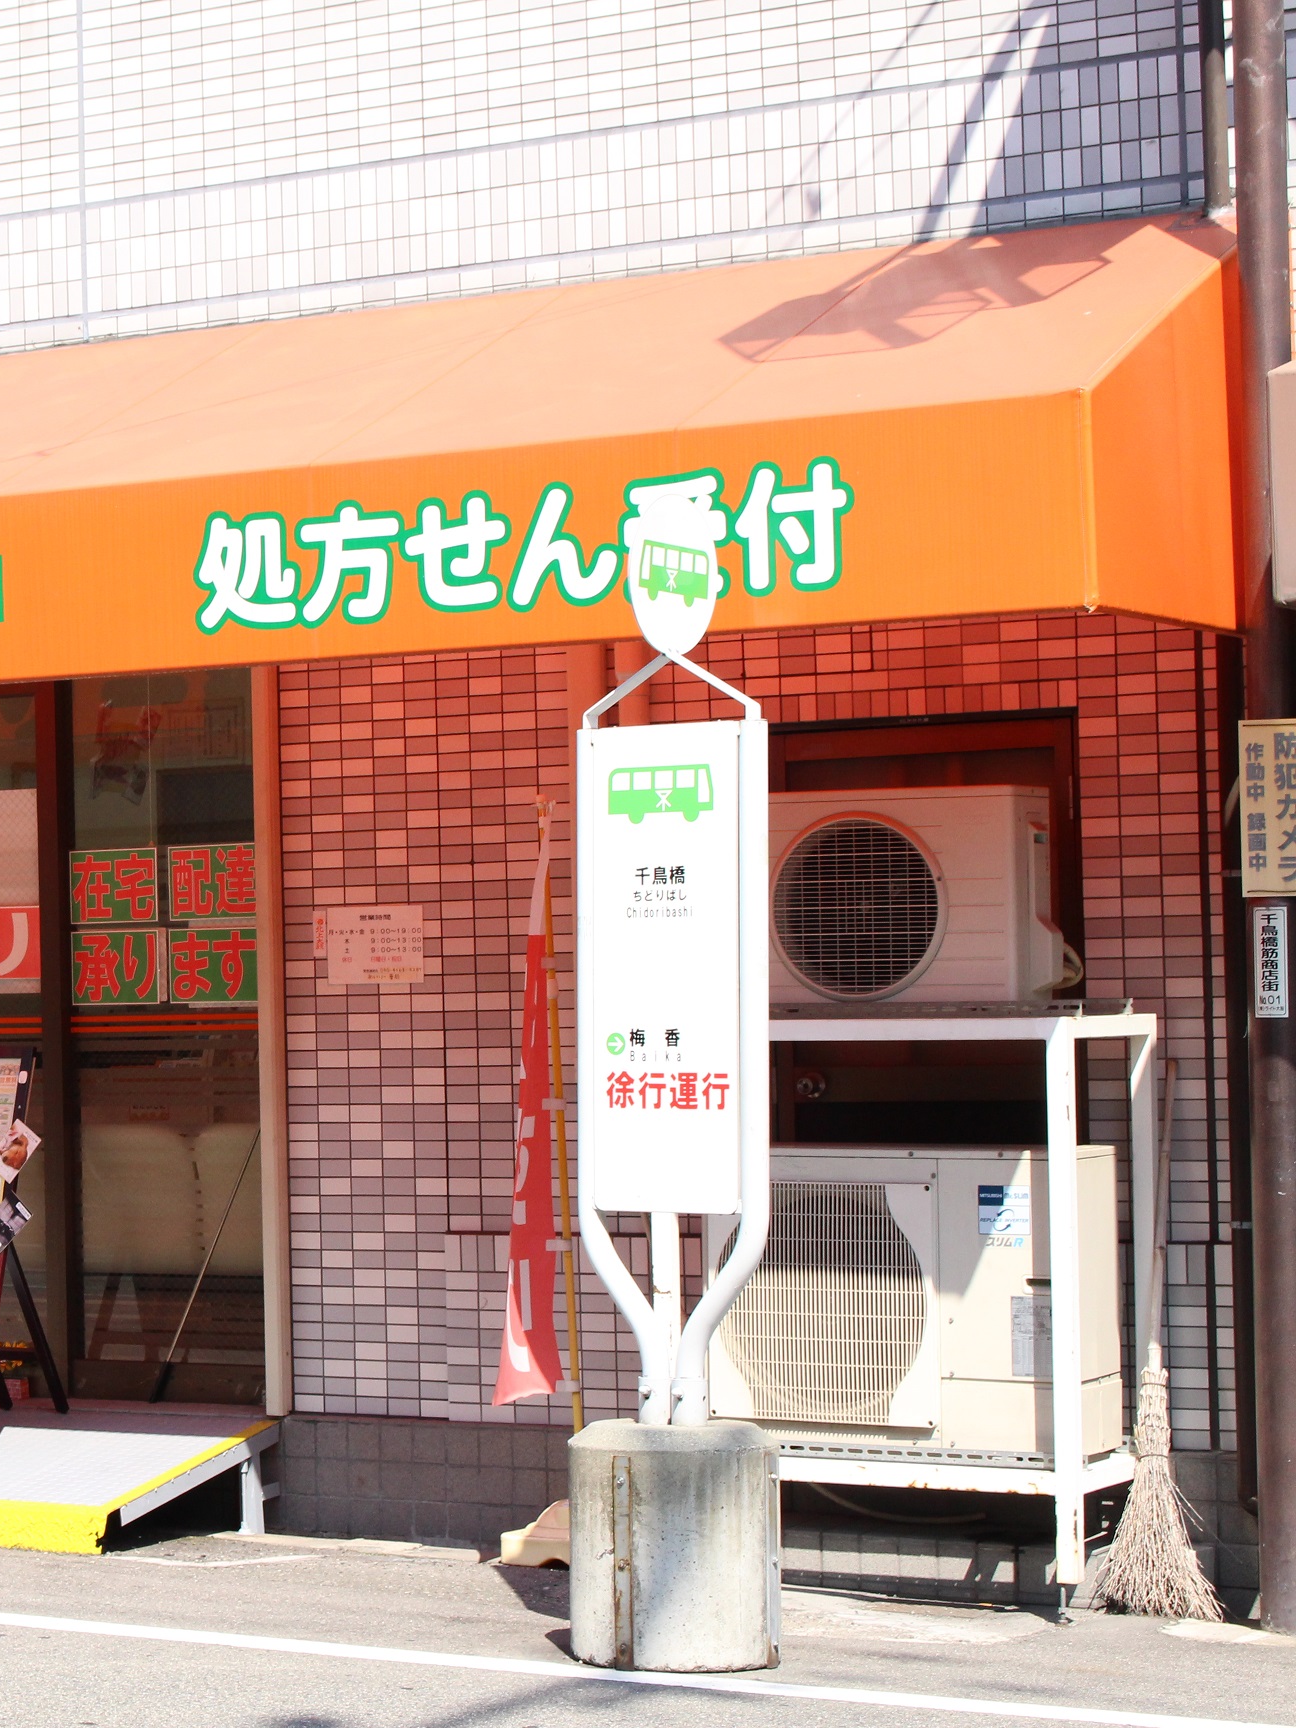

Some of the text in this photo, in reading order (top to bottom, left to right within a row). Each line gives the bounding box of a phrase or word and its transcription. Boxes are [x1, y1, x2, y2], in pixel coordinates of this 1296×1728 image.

[1245, 743, 1267, 872] 作動中 録画中
[635, 866, 685, 885] 千鳥橋
[633, 889, 687, 902] ちどりばし
[626, 906, 693, 918] Chidoribashi
[1260, 914, 1279, 991] 千鳥橋筋商店街
[629, 1051, 681, 1062] Baika
[606, 1071, 730, 1110] 徐行運行
